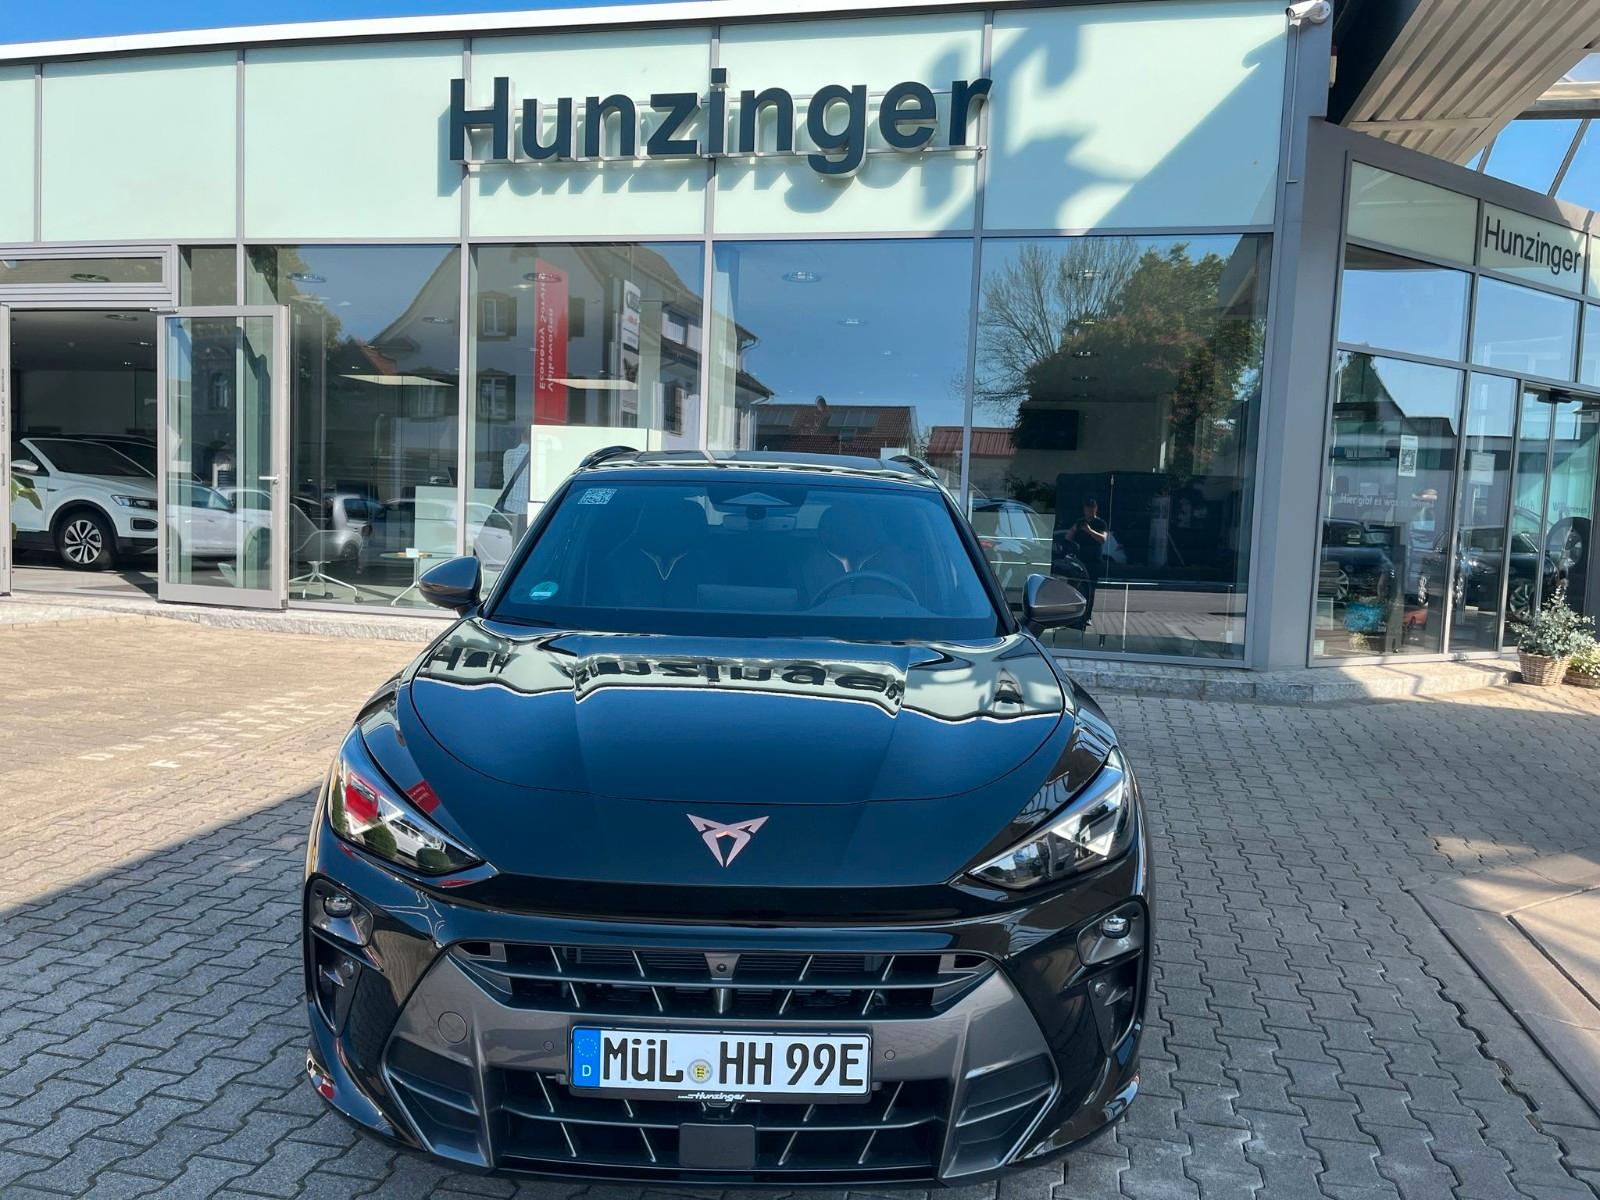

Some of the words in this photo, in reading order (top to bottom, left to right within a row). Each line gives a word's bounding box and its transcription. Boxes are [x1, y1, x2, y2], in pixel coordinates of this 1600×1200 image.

[449, 68, 993, 177] Hunzinger
[1484, 215, 1581, 276] Hunzinger
[580, 1064, 592, 1077] D
[718, 1041, 773, 1086] HH
[786, 1043, 864, 1087] 99E
[689, 1092, 746, 1102] Hunzinger
